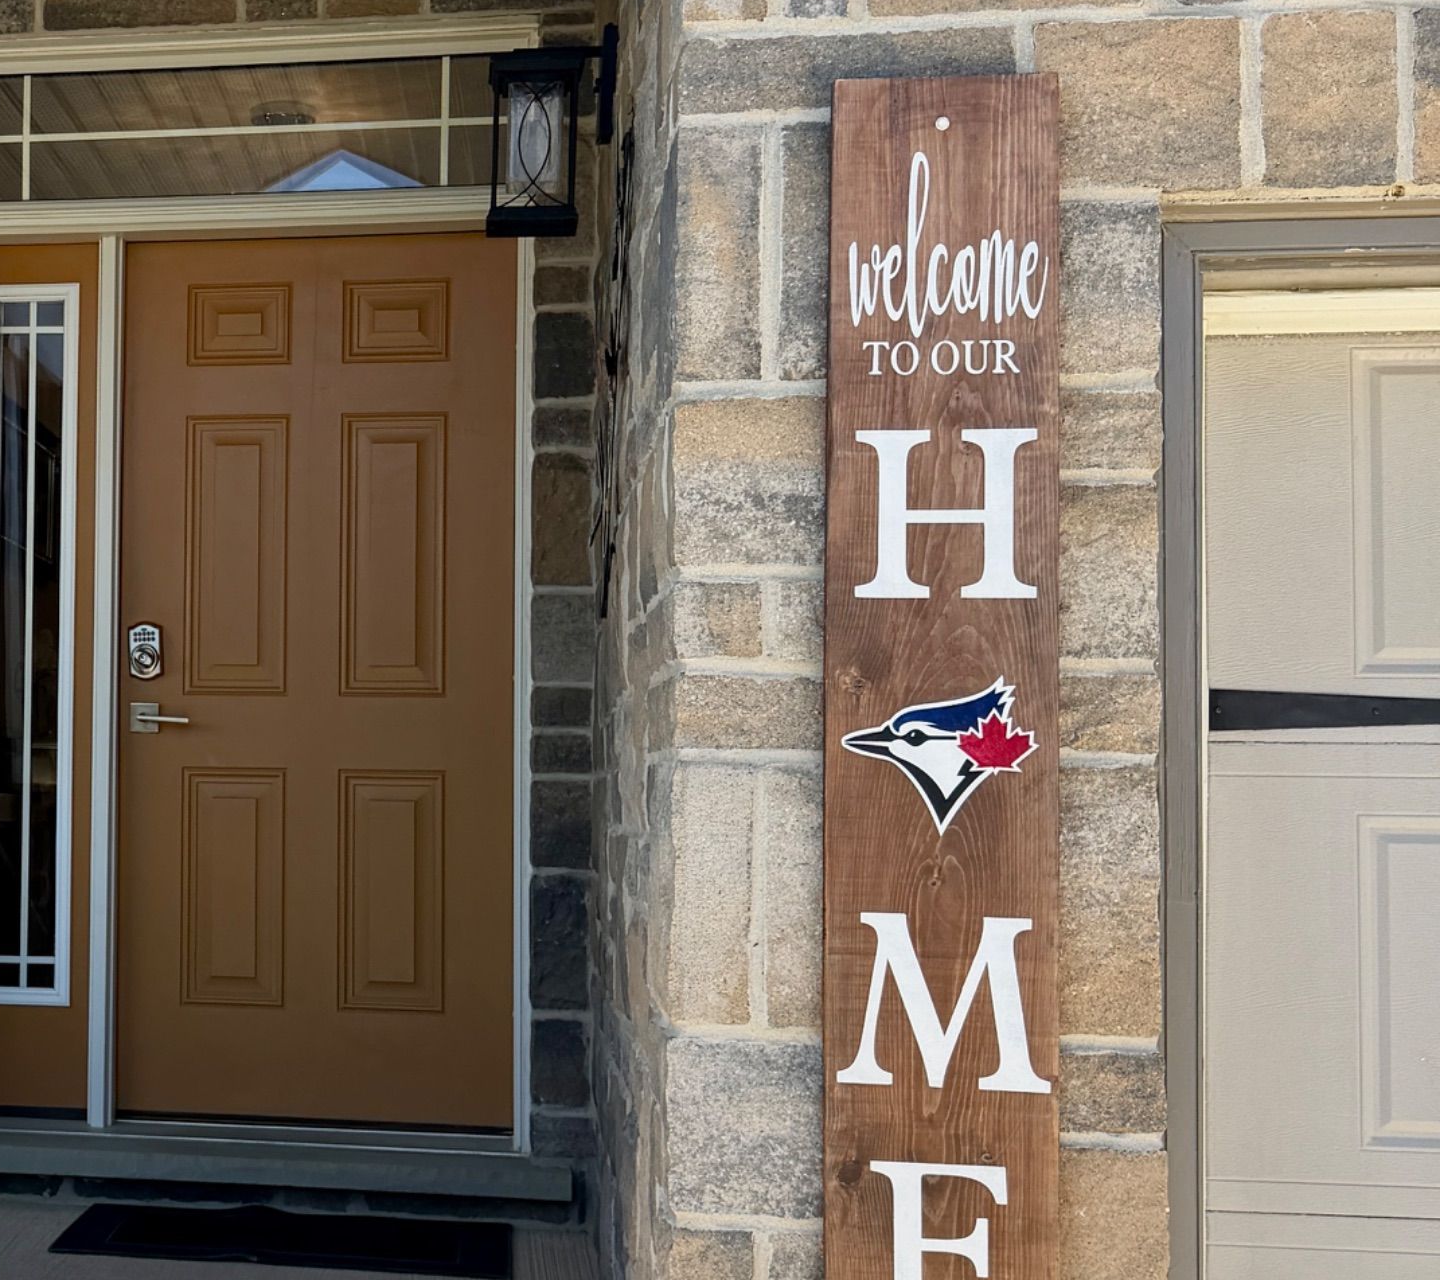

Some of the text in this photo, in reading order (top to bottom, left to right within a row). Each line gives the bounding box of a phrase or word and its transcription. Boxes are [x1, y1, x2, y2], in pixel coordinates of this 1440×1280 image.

[847, 150, 1049, 339] welcome
[862, 338, 1021, 376] TO OUR
